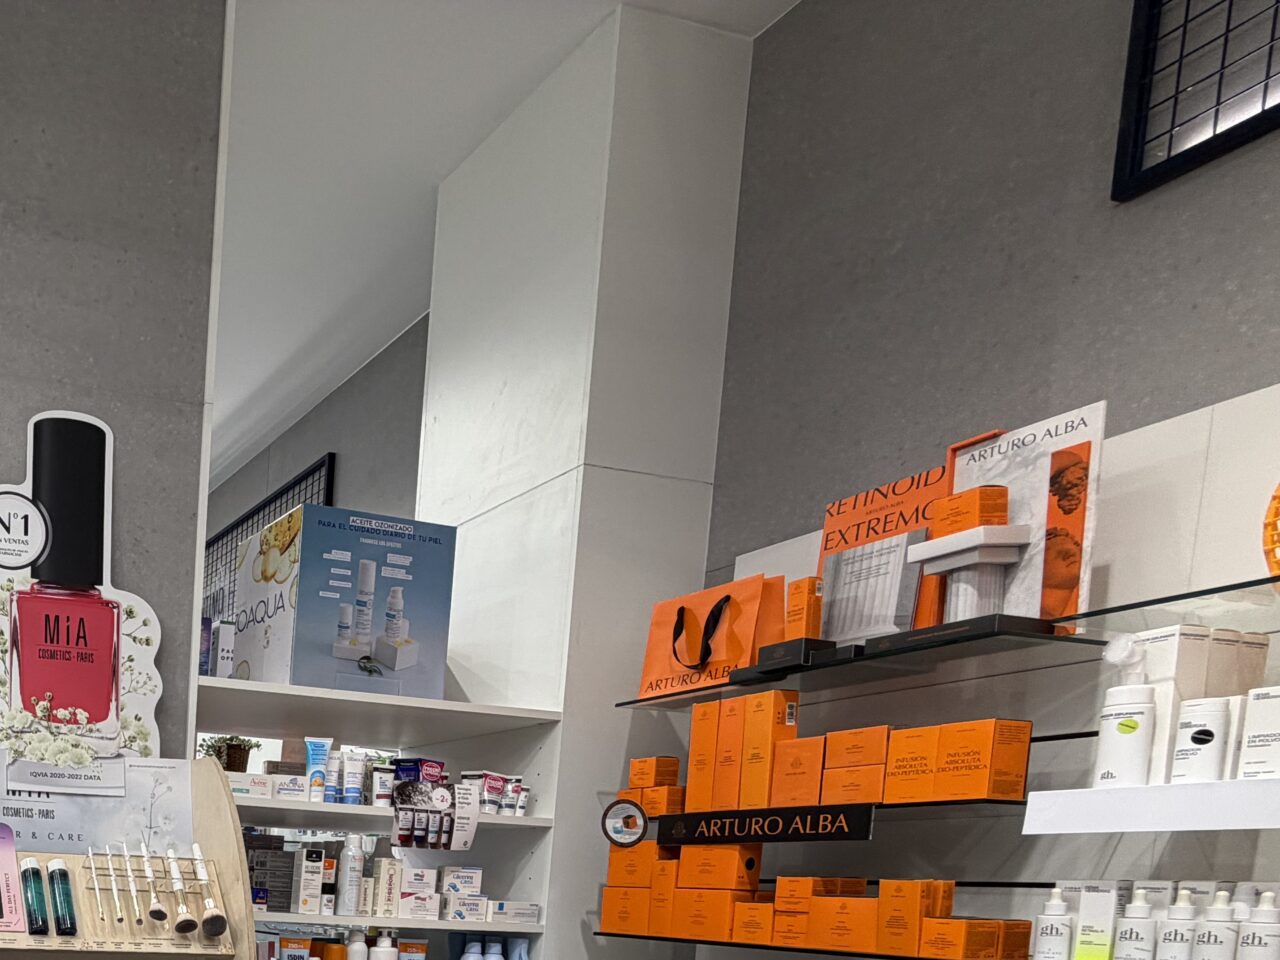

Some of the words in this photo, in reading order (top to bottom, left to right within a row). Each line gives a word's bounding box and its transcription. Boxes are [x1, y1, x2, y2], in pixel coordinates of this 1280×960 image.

[966, 432, 1037, 466] ARTURO
[1040, 416, 1089, 443] ALBA
[350, 517, 373, 527] ACEITE
[374, 520, 413, 533] OZONIZADO
[317, 519, 337, 530] PARA
[338, 522, 348, 531] EL
[348, 524, 381, 537] CUIDADO
[382, 527, 406, 540] DIARIO
[407, 532, 417, 541] DE
[418, 534, 427, 542] TU
[428, 535, 443, 546] PIEL
[3, 537, 30, 546] VENTAS
[37, 648, 72, 661] COSMETICS
[76, 651, 95, 664] PARIS
[644, 671, 702, 693] ARTURO
[944, 757, 981, 766] ABSOLUTA
[29, 771, 49, 779] IQVIA
[49, 772, 83, 781] 2020-2022
[83, 773, 102, 782] DATA
[1100, 769, 1117, 781] gh.
[2, 806, 35, 819] COSMETICS
[38, 807, 56, 820] PARIS
[695, 816, 784, 838] ARTURO
[788, 813, 850, 835] ALBA
[48, 832, 85, 843] CARE
[1039, 923, 1064, 937] gh.
[1119, 928, 1145, 942] gh.
[1162, 929, 1190, 943] gh.
[1196, 931, 1224, 945] gh.
[1240, 932, 1269, 947] gh.
